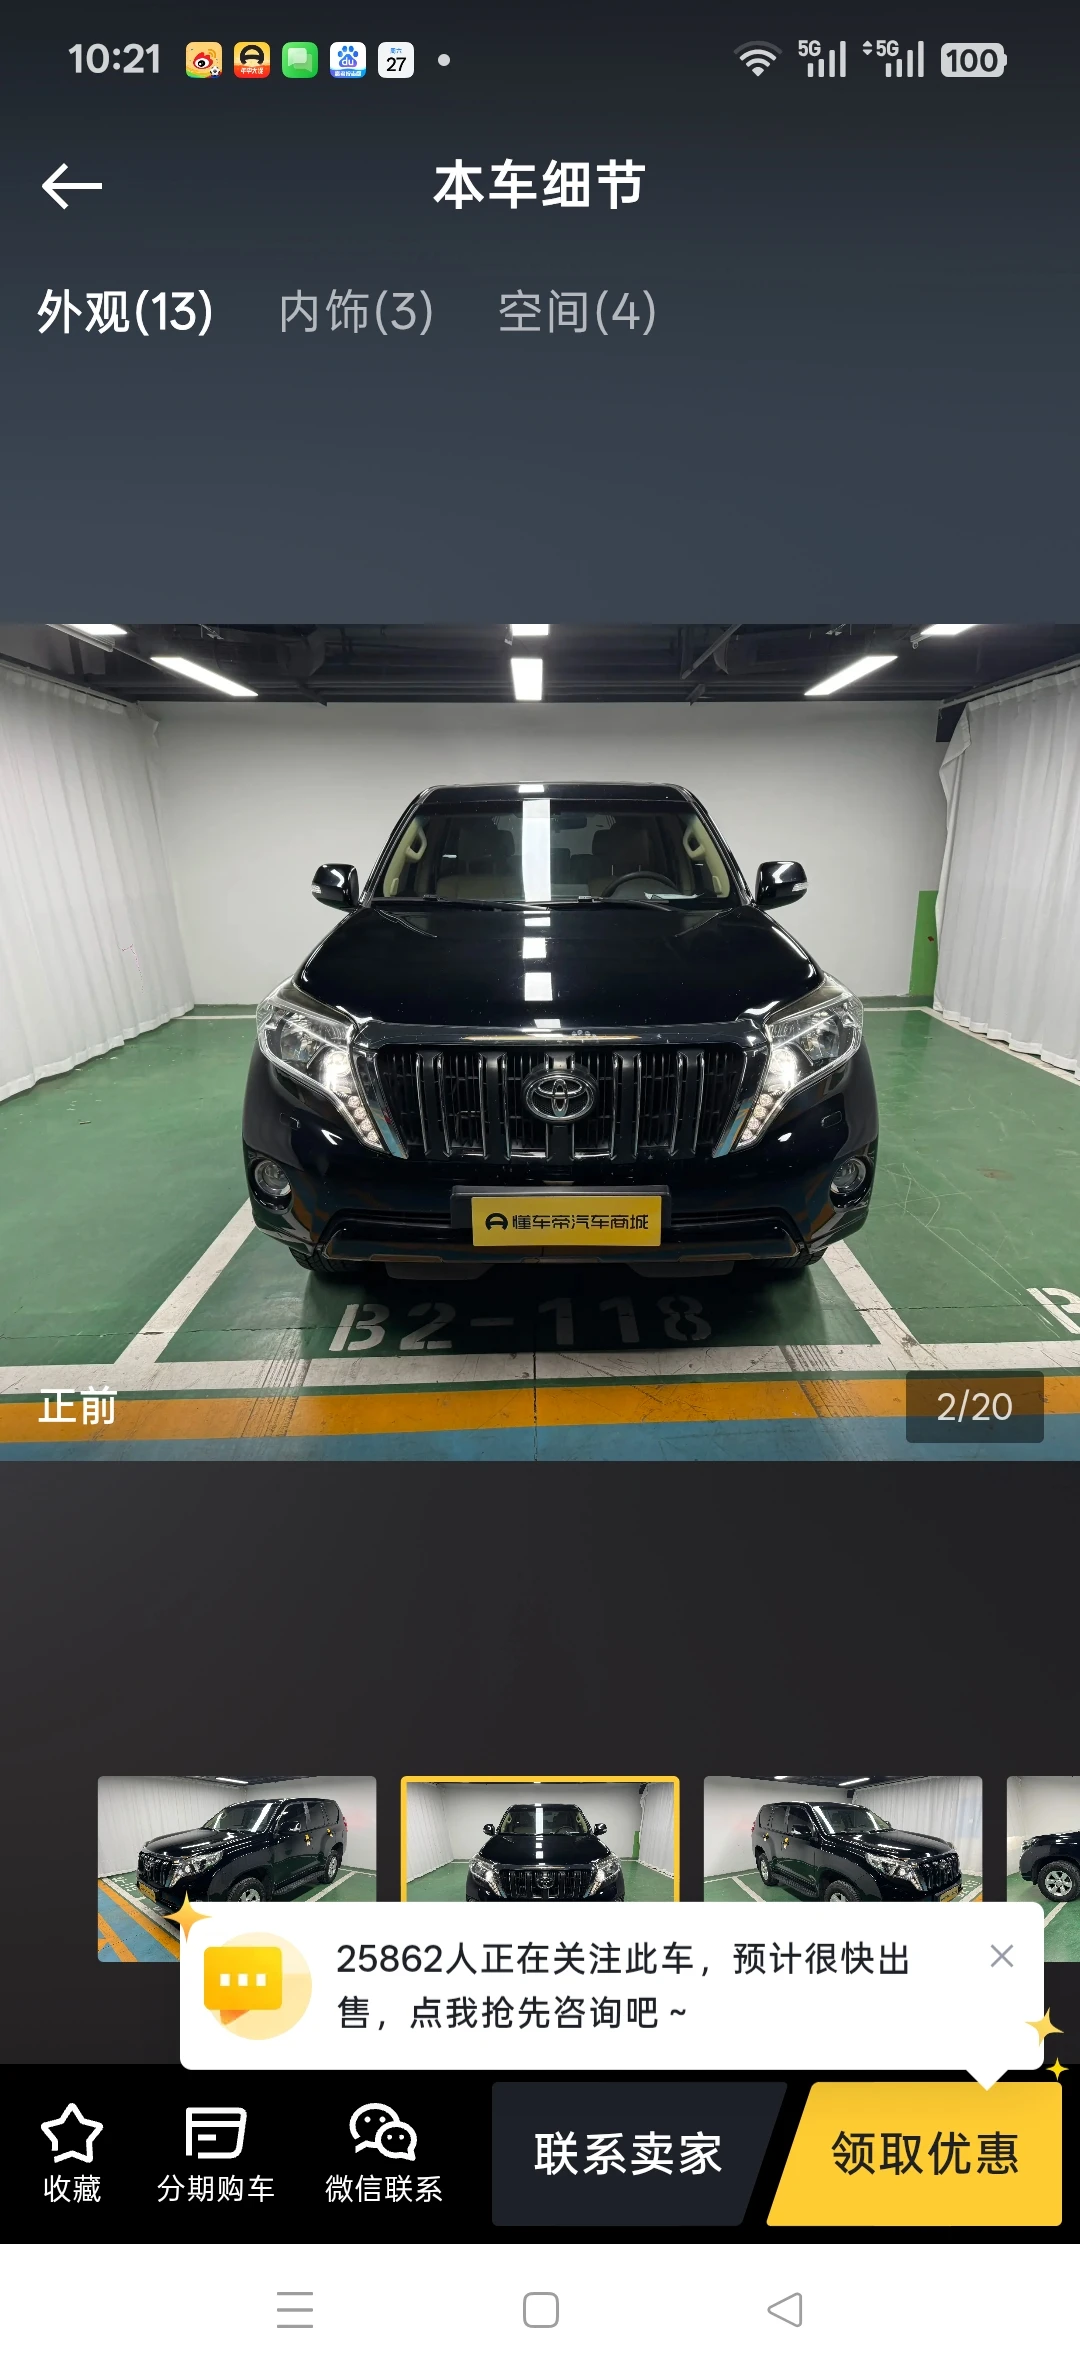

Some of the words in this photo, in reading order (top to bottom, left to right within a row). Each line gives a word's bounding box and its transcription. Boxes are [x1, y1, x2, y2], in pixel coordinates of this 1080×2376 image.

[68, 43, 160, 74] 10:21
[798, 39, 822, 57] 5G
[876, 39, 900, 57] 5G
[945, 48, 999, 73] 100
[386, 56, 407, 72] 27
[432, 157, 647, 210] 本车细节
[36, 288, 213, 337] 外观(13)
[281, 288, 433, 336] 内饰(3)
[499, 288, 656, 336] 空间(4)
[512, 1214, 649, 1230] 懂车帝汽车商城
[329, 1295, 712, 1352] B2-118
[336, 1940, 910, 1977] 25862人正在关注此车，预计很快出
[533, 2130, 724, 2176] 联系卖家
[831, 2130, 1020, 2176] 领取优惠
[43, 2173, 102, 2204] 收藏
[156, 2173, 275, 2204] 分期购车
[324, 2173, 443, 2204] 微信联系
